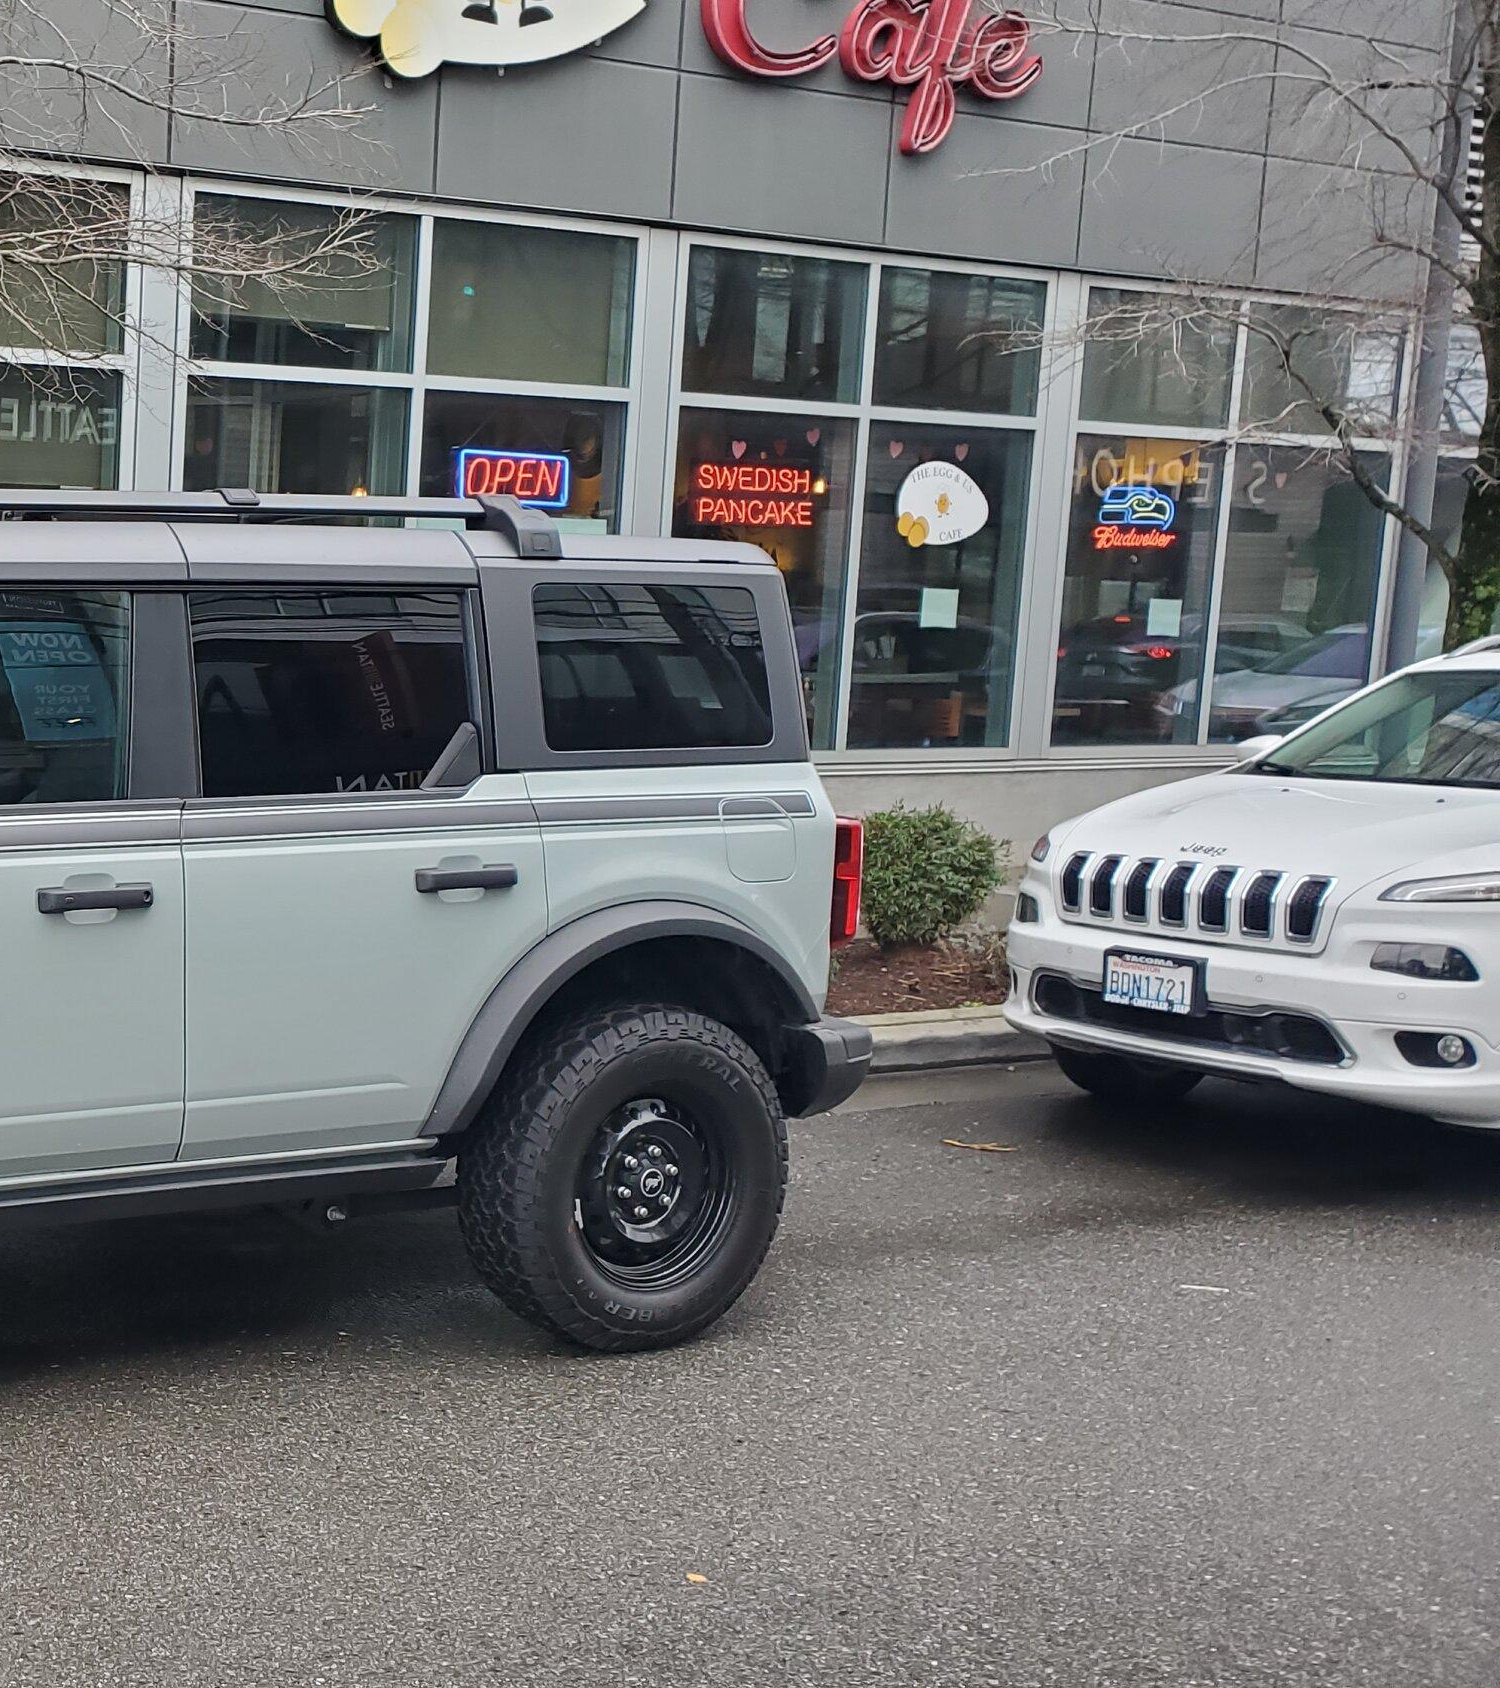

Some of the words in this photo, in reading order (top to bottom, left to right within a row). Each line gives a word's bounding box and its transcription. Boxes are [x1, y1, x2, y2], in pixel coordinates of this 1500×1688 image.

[466, 457, 562, 497] OPEN
[698, 464, 810, 494] SWEDISH
[911, 467, 931, 483] THE
[933, 466, 953, 479] EGG
[954, 474, 961, 483] &
[962, 478, 974, 494] US
[698, 497, 813, 527] PANCAKE
[1093, 525, 1176, 550] Budweiser
[1180, 842, 1228, 857] Jeep
[1112, 959, 1161, 974] WASHINGTON
[1123, 954, 1174, 967] TACOMA
[1110, 970, 1186, 1005] BDN1721
